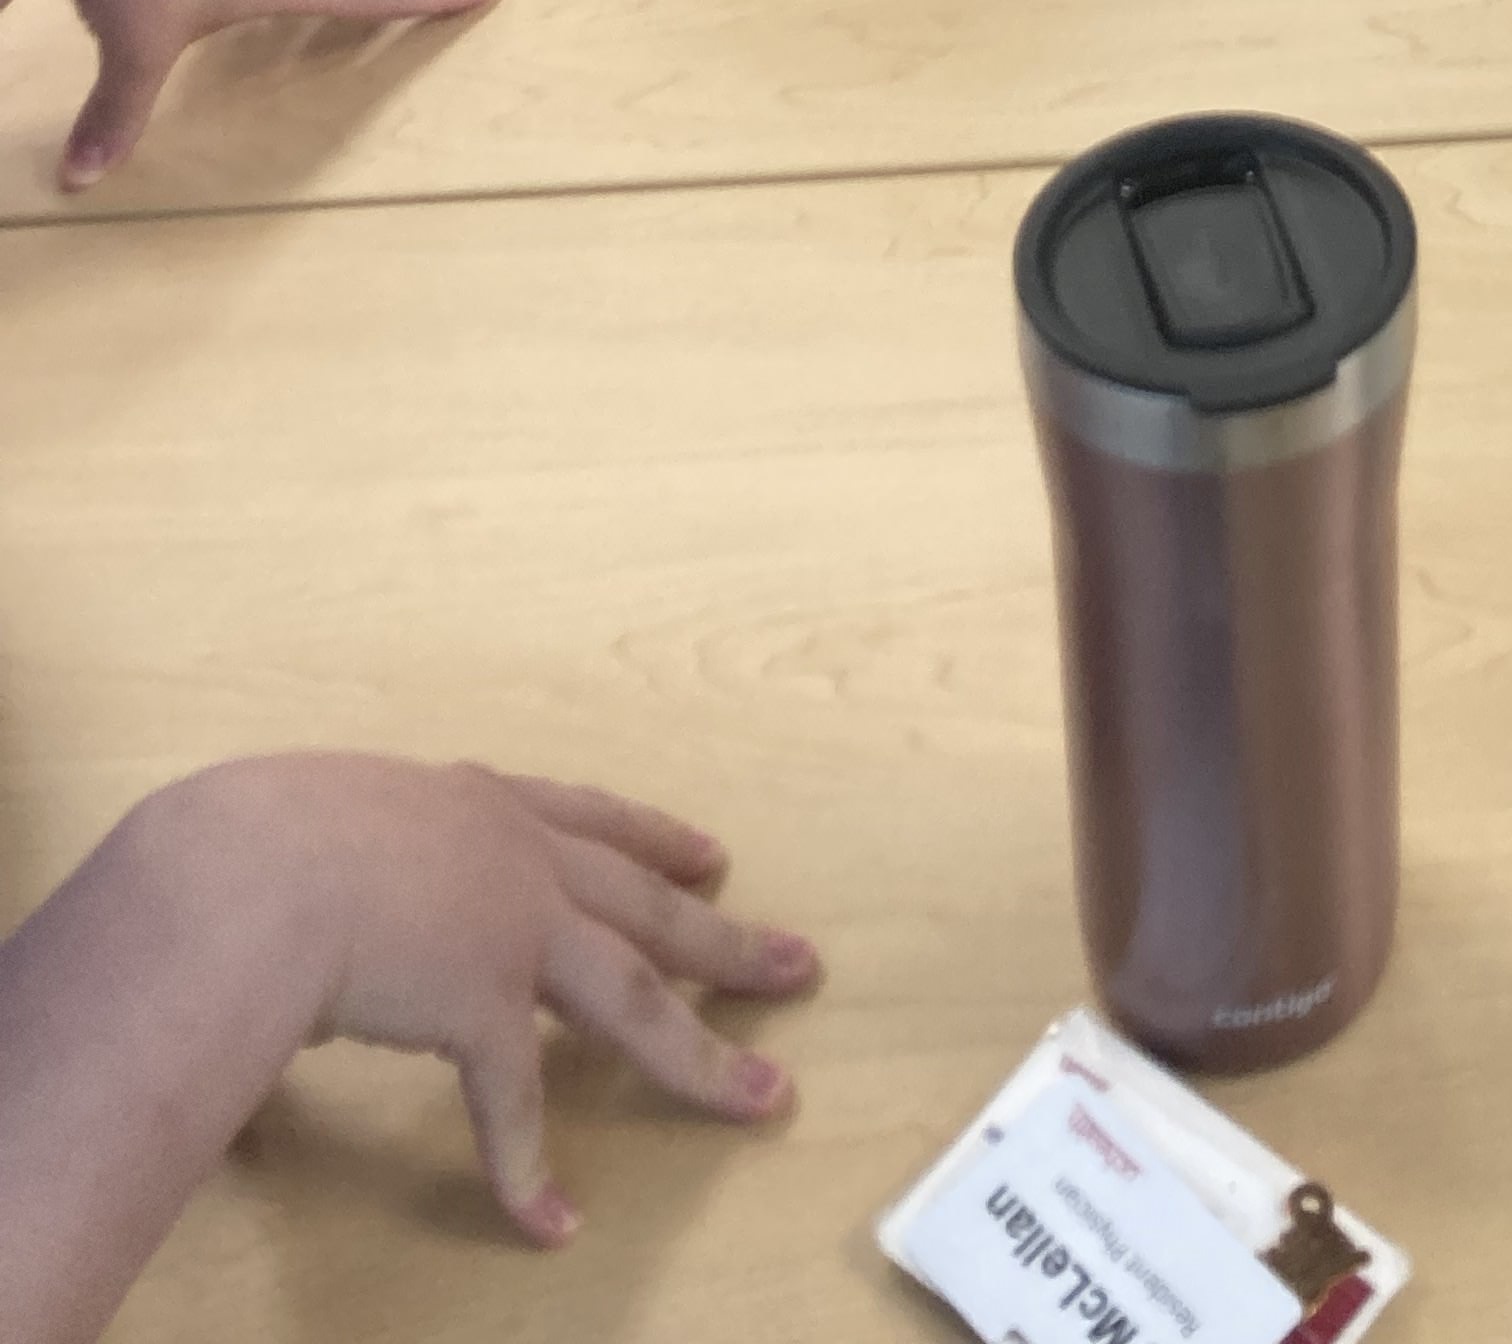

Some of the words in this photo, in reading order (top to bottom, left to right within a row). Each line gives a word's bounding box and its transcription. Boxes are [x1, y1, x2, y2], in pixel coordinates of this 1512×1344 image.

[984, 1182, 1139, 1344] McLellan
[1054, 1175, 1130, 1263] Physician
[1124, 1254, 1201, 1340] Resident
